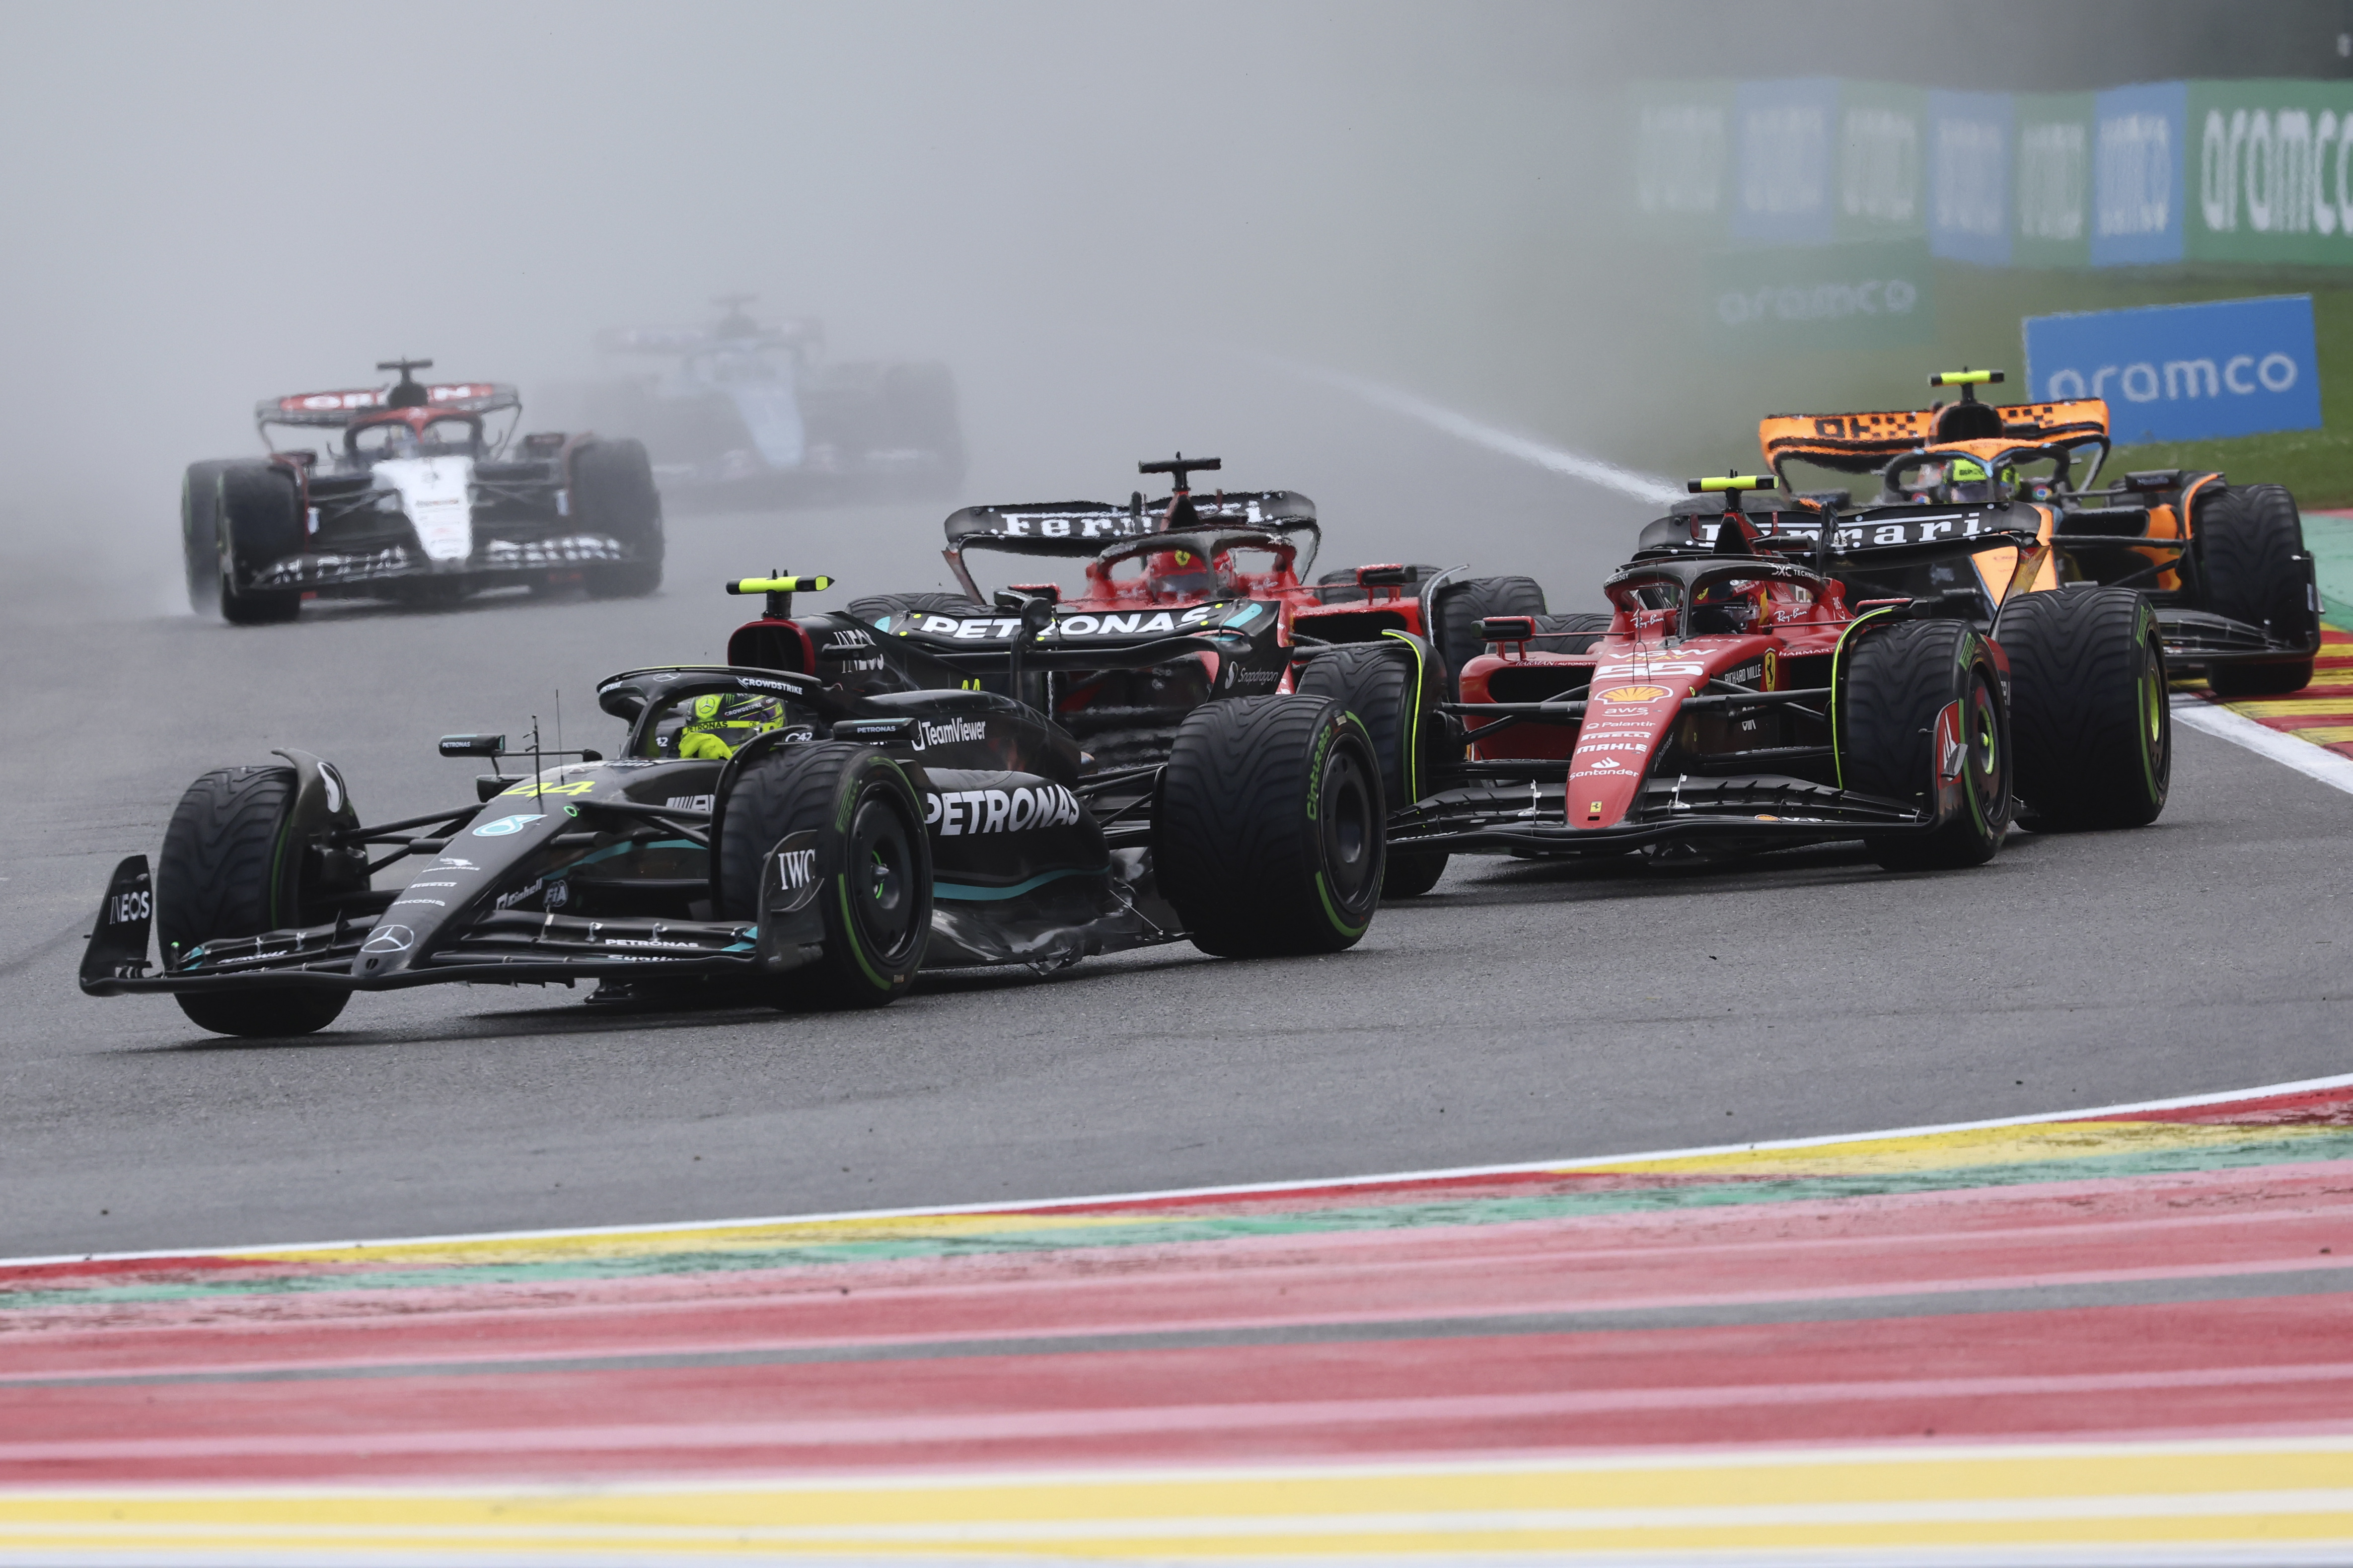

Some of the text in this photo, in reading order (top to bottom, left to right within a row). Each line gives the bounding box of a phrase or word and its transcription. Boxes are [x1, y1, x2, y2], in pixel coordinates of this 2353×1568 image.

[2048, 353, 2298, 403] aramco
[920, 607, 1212, 639] PETONAS
[1630, 614, 1664, 629] Ray-Ban
[1773, 608, 1808, 623] Ray-Ban
[1608, 649, 1718, 659] VGW
[1779, 648, 1830, 657] HARMAN
[1238, 667, 1279, 685] Snapdragon
[1593, 661, 1705, 682] 55
[1725, 664, 1762, 684] RICHARD MILLE
[742, 678, 803, 695] CROWDSTRIKE
[724, 702, 763, 716] CROWDSTRIKE
[1603, 707, 1649, 715] aws
[687, 721, 729, 733] PETRONAS
[922, 717, 986, 746] TeamViewer
[1581, 731, 1652, 742] PIRELLI
[1576, 743, 1648, 755] MAHLE
[1569, 769, 1639, 781] Santander
[500, 781, 596, 797] 44
[924, 784, 1080, 836] PETRONAS
[778, 849, 815, 890] IWC
[109, 890, 150, 925] INEOS
[605, 939, 699, 947] PETRONAS
